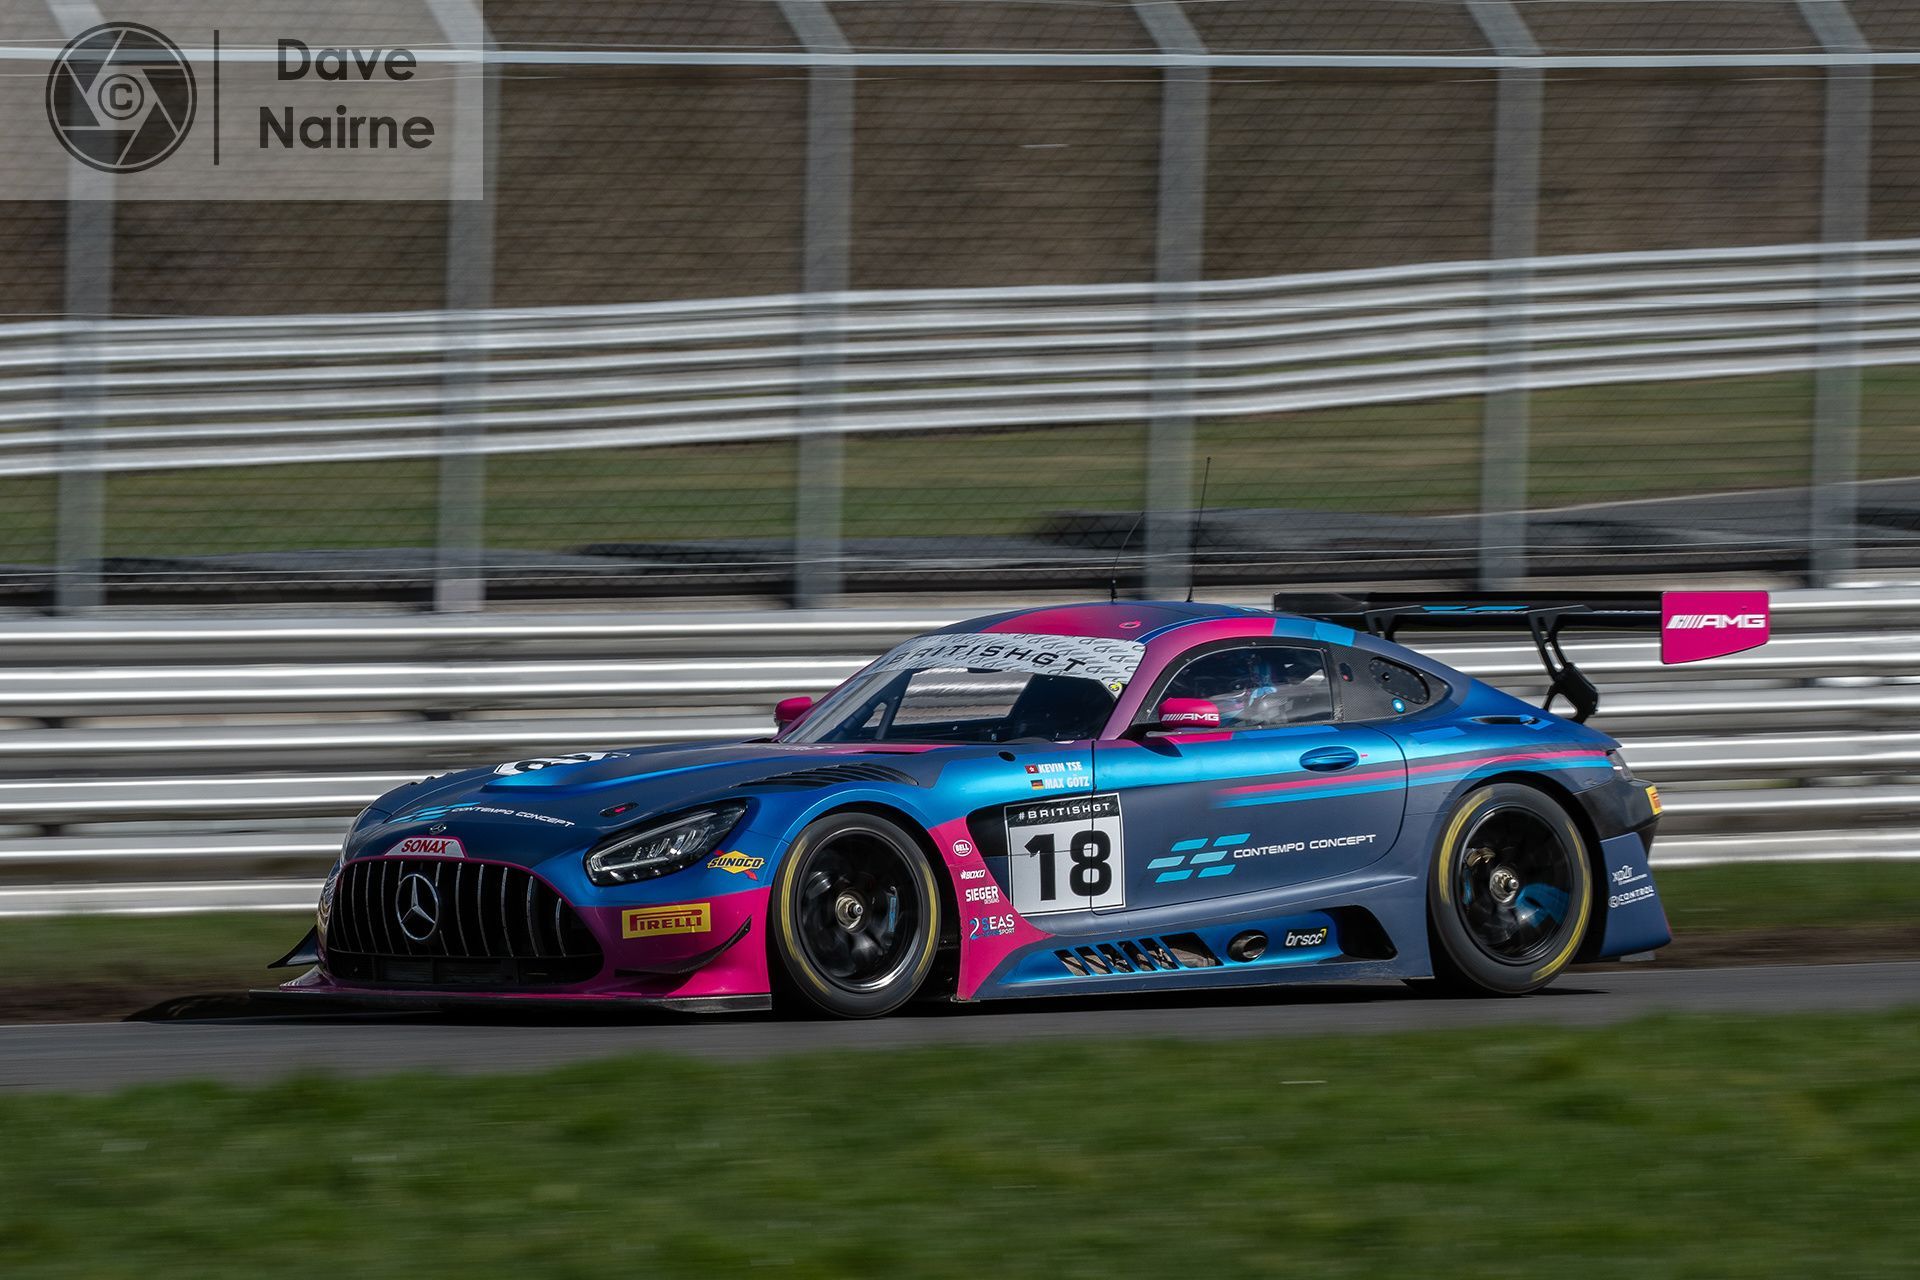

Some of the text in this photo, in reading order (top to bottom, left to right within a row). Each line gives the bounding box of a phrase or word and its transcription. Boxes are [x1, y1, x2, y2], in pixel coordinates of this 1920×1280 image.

[889, 645, 1086, 672] BRITISHGT
[1038, 761, 1083, 774] KEVIN TSE
[1045, 773, 1090, 789] MAX GÖTZ
[451, 806, 576, 828] CONTEMPO CONCEPT
[1018, 803, 1110, 820] #BRITISHGT
[401, 839, 450, 854] SONAX
[955, 843, 970, 852] BELL
[1233, 834, 1376, 858] CONTEMPO CONCEPT
[709, 857, 764, 868] SUNOCO
[1024, 829, 1113, 902] 18
[965, 885, 999, 902] SIEGER
[629, 909, 703, 932] PIRELLI
[981, 913, 1015, 931] SEAS
[1285, 931, 1323, 947] brscc
